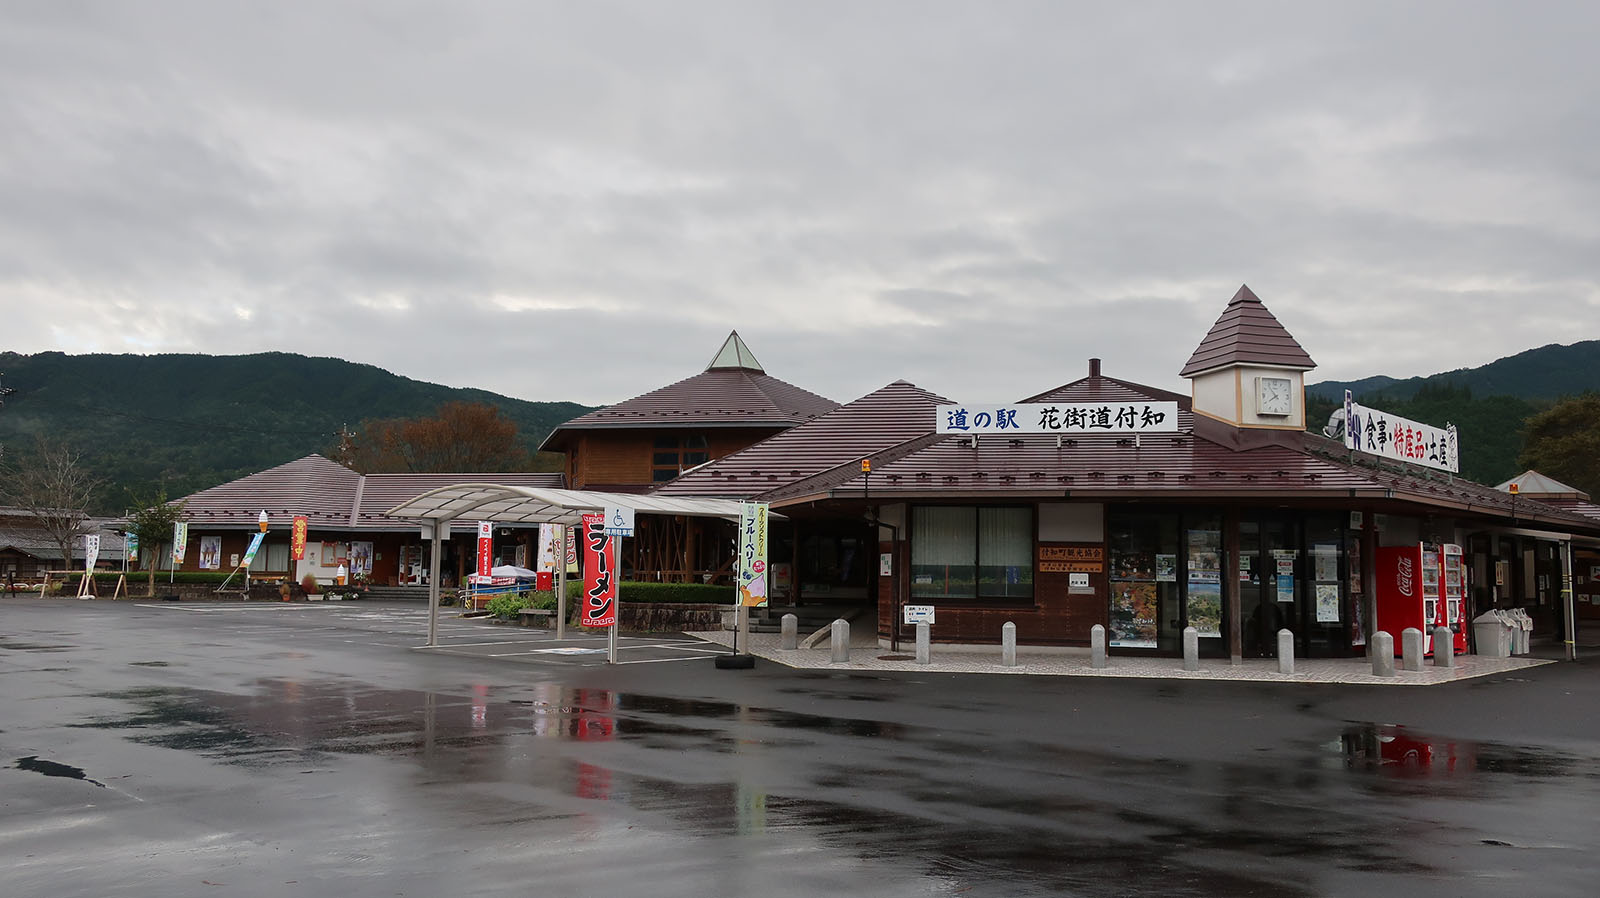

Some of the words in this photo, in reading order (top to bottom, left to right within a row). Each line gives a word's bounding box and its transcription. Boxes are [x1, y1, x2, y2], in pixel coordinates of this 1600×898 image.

[946, 407, 1020, 431] 道の駅
[1038, 405, 1166, 430] 花街道付知
[745, 517, 756, 568] ブルーベリー
[588, 523, 614, 619] ラーメン
